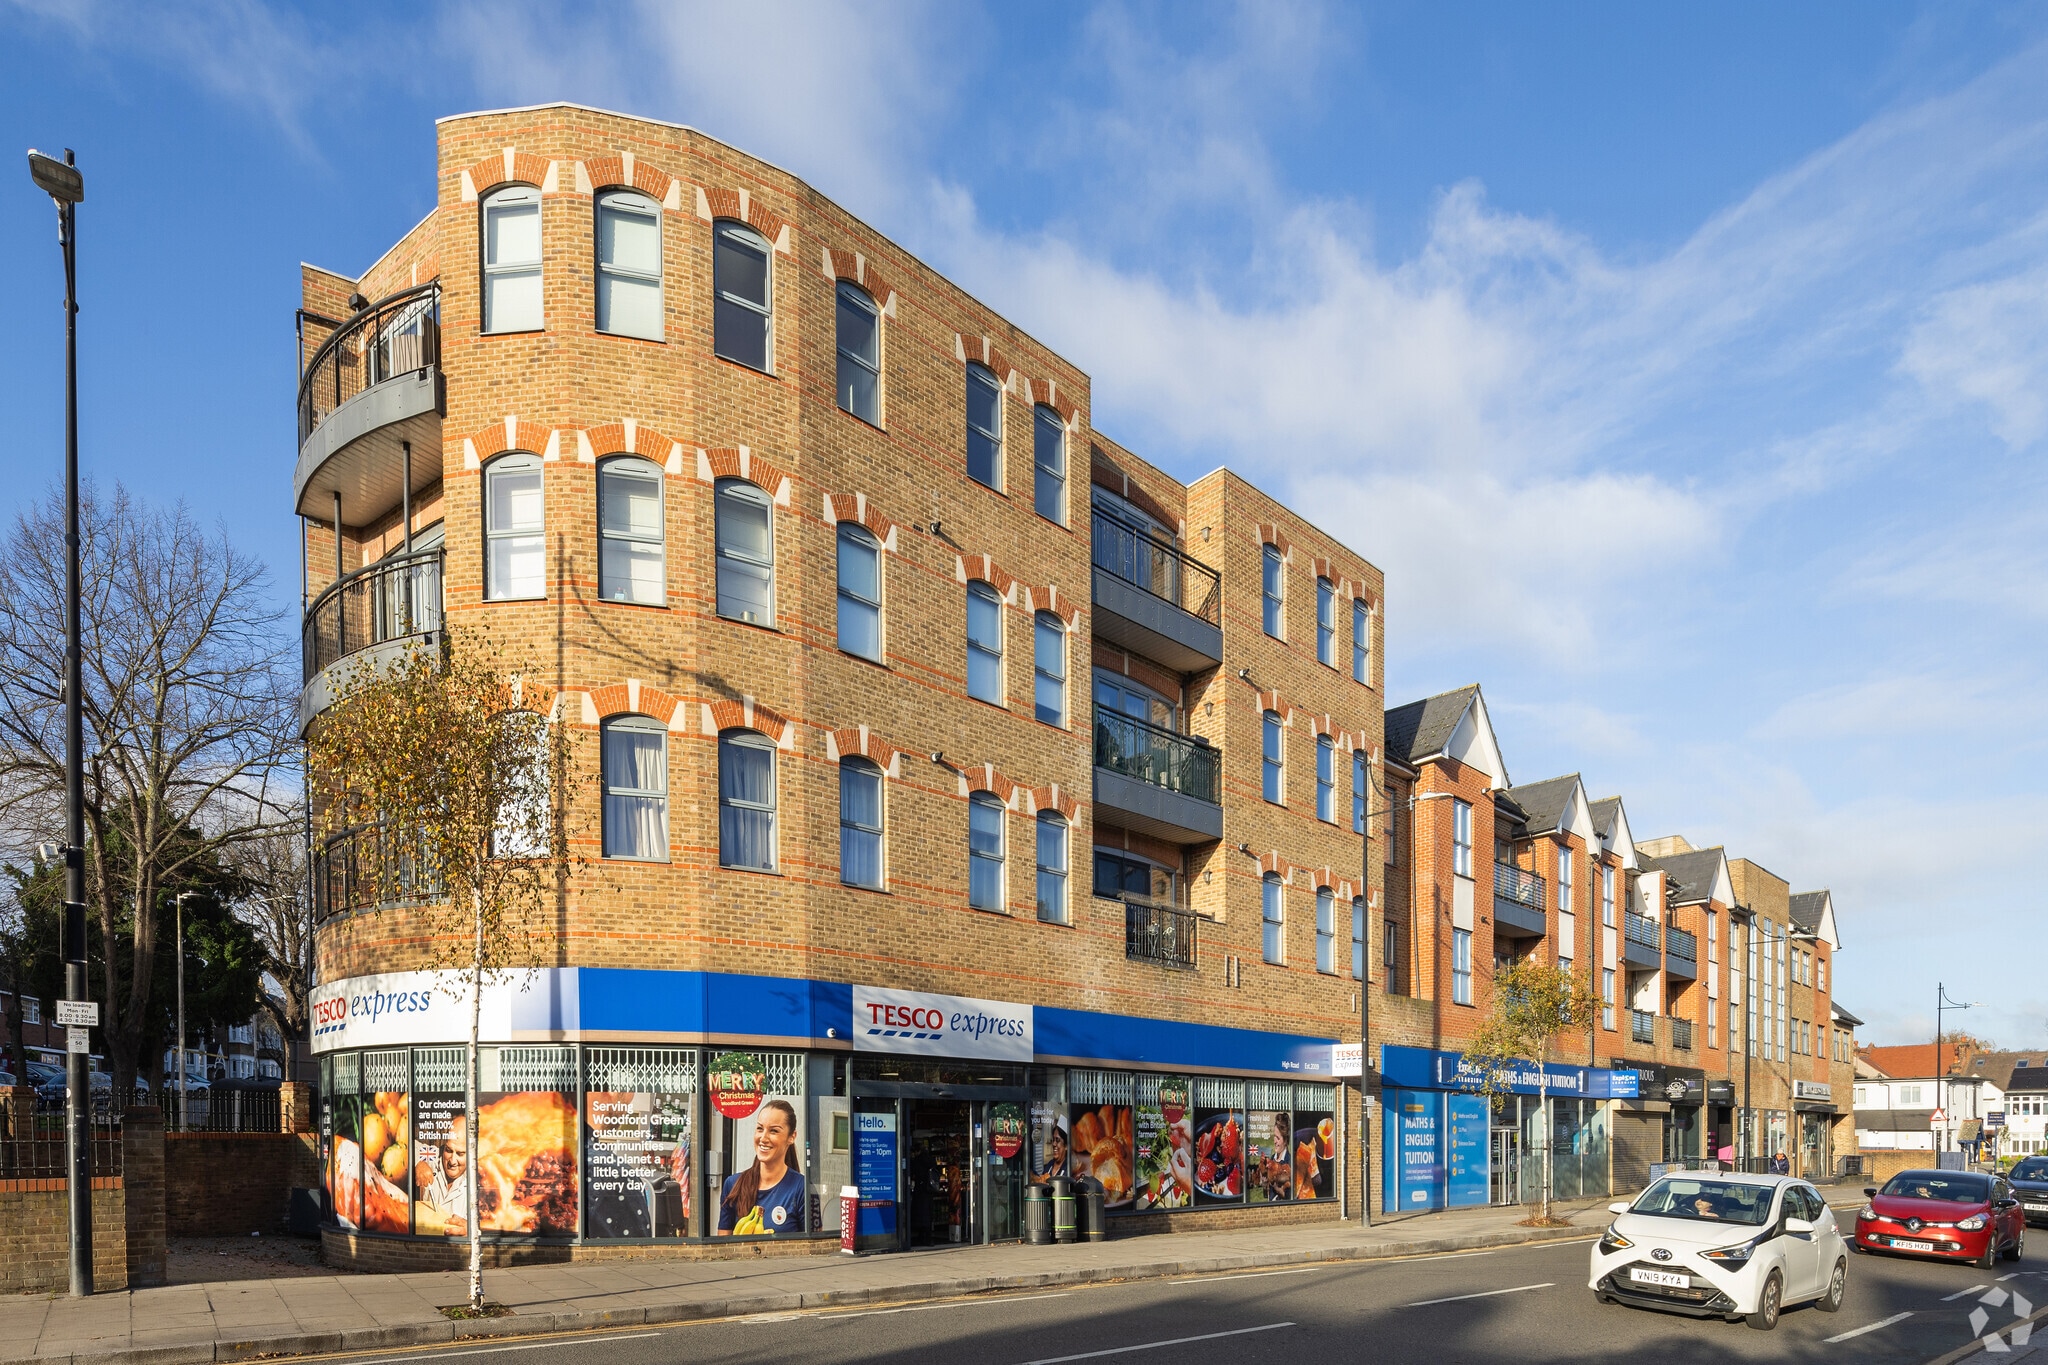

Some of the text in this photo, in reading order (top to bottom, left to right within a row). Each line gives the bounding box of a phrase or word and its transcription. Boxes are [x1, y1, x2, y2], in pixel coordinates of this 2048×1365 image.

[313, 989, 430, 1025] TESCO express
[867, 1003, 1024, 1040] TESCO express
[1282, 1061, 1290, 1069] High
[708, 1071, 764, 1091] MERRY
[1518, 1076, 1522, 1084] &
[1552, 1074, 1576, 1088] TUITION
[419, 1100, 466, 1108] Our cheddars
[592, 1101, 633, 1114] Serving
[592, 1114, 648, 1124] Woodford
[859, 1116, 886, 1128] Hello.
[1248, 1114, 1262, 1122] Freshly
[1405, 1118, 1435, 1128] MATHS &
[419, 1121, 454, 1129] with 100%
[988, 1117, 1024, 1134] MERRY
[419, 1131, 441, 1139] British
[592, 1128, 654, 1139] customers,
[593, 1141, 664, 1150] communities
[1405, 1134, 1435, 1146] ENGLISH
[877, 1148, 892, 1157] 10pm
[1405, 1152, 1434, 1164] TUITION
[593, 1154, 661, 1166] and planet a
[593, 1167, 656, 1177] little better
[593, 1180, 646, 1192] every day
[1638, 1272, 1681, 1285] VN19 KYA
